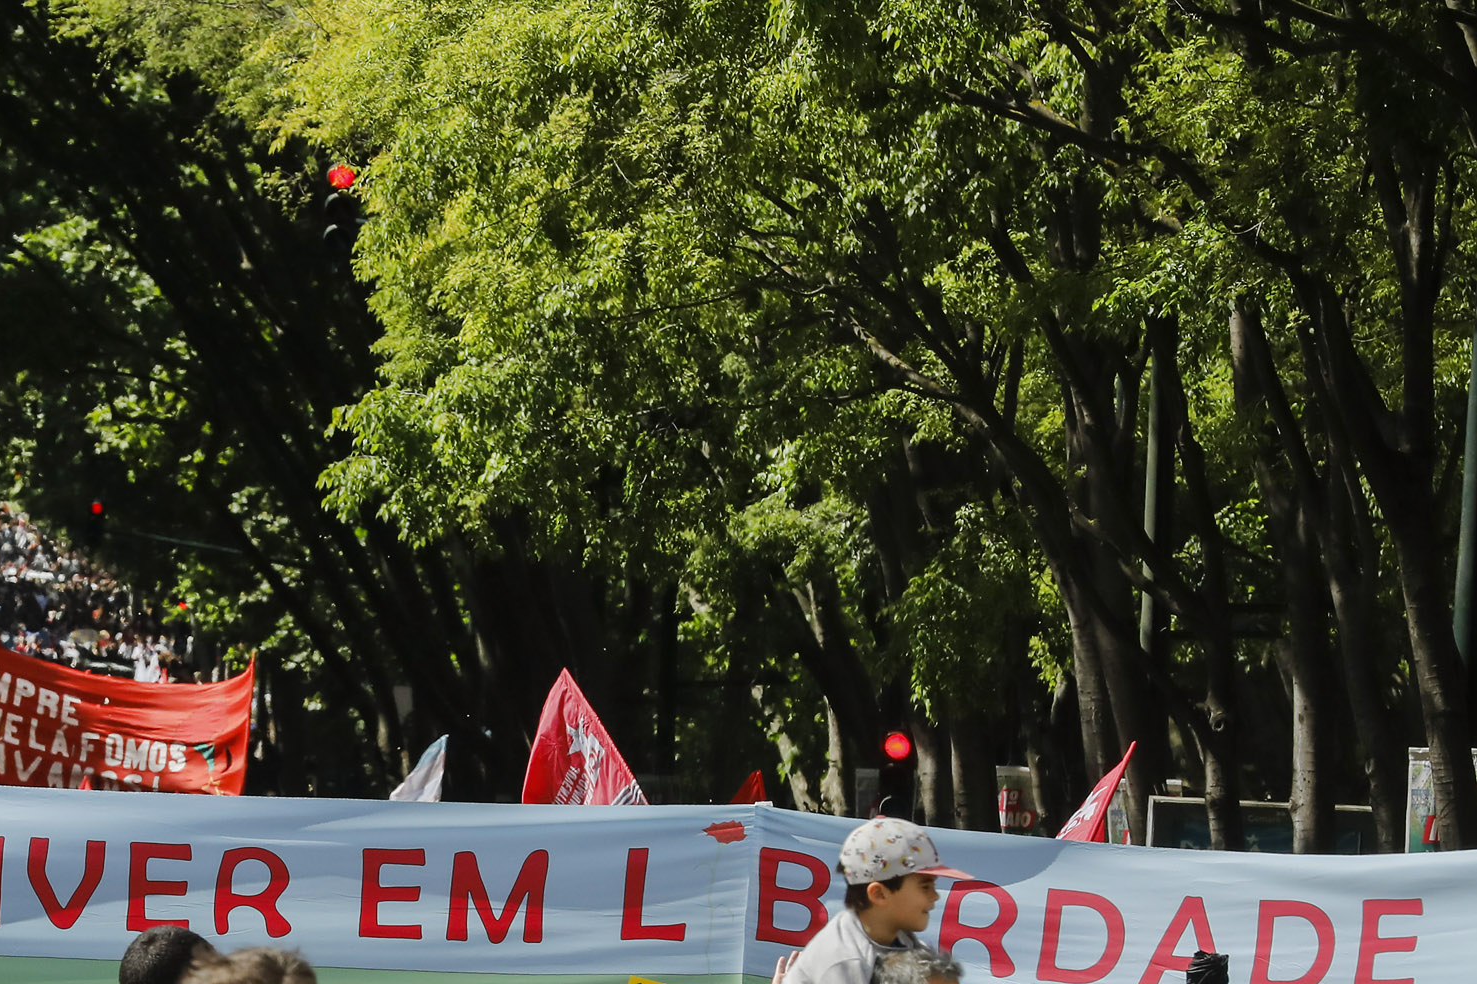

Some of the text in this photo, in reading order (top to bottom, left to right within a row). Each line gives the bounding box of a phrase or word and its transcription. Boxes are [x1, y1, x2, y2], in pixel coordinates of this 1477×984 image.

[28, 718, 70, 758] LÁ
[80, 731, 187, 774] FOMOS
[358, 847, 549, 944] EM
